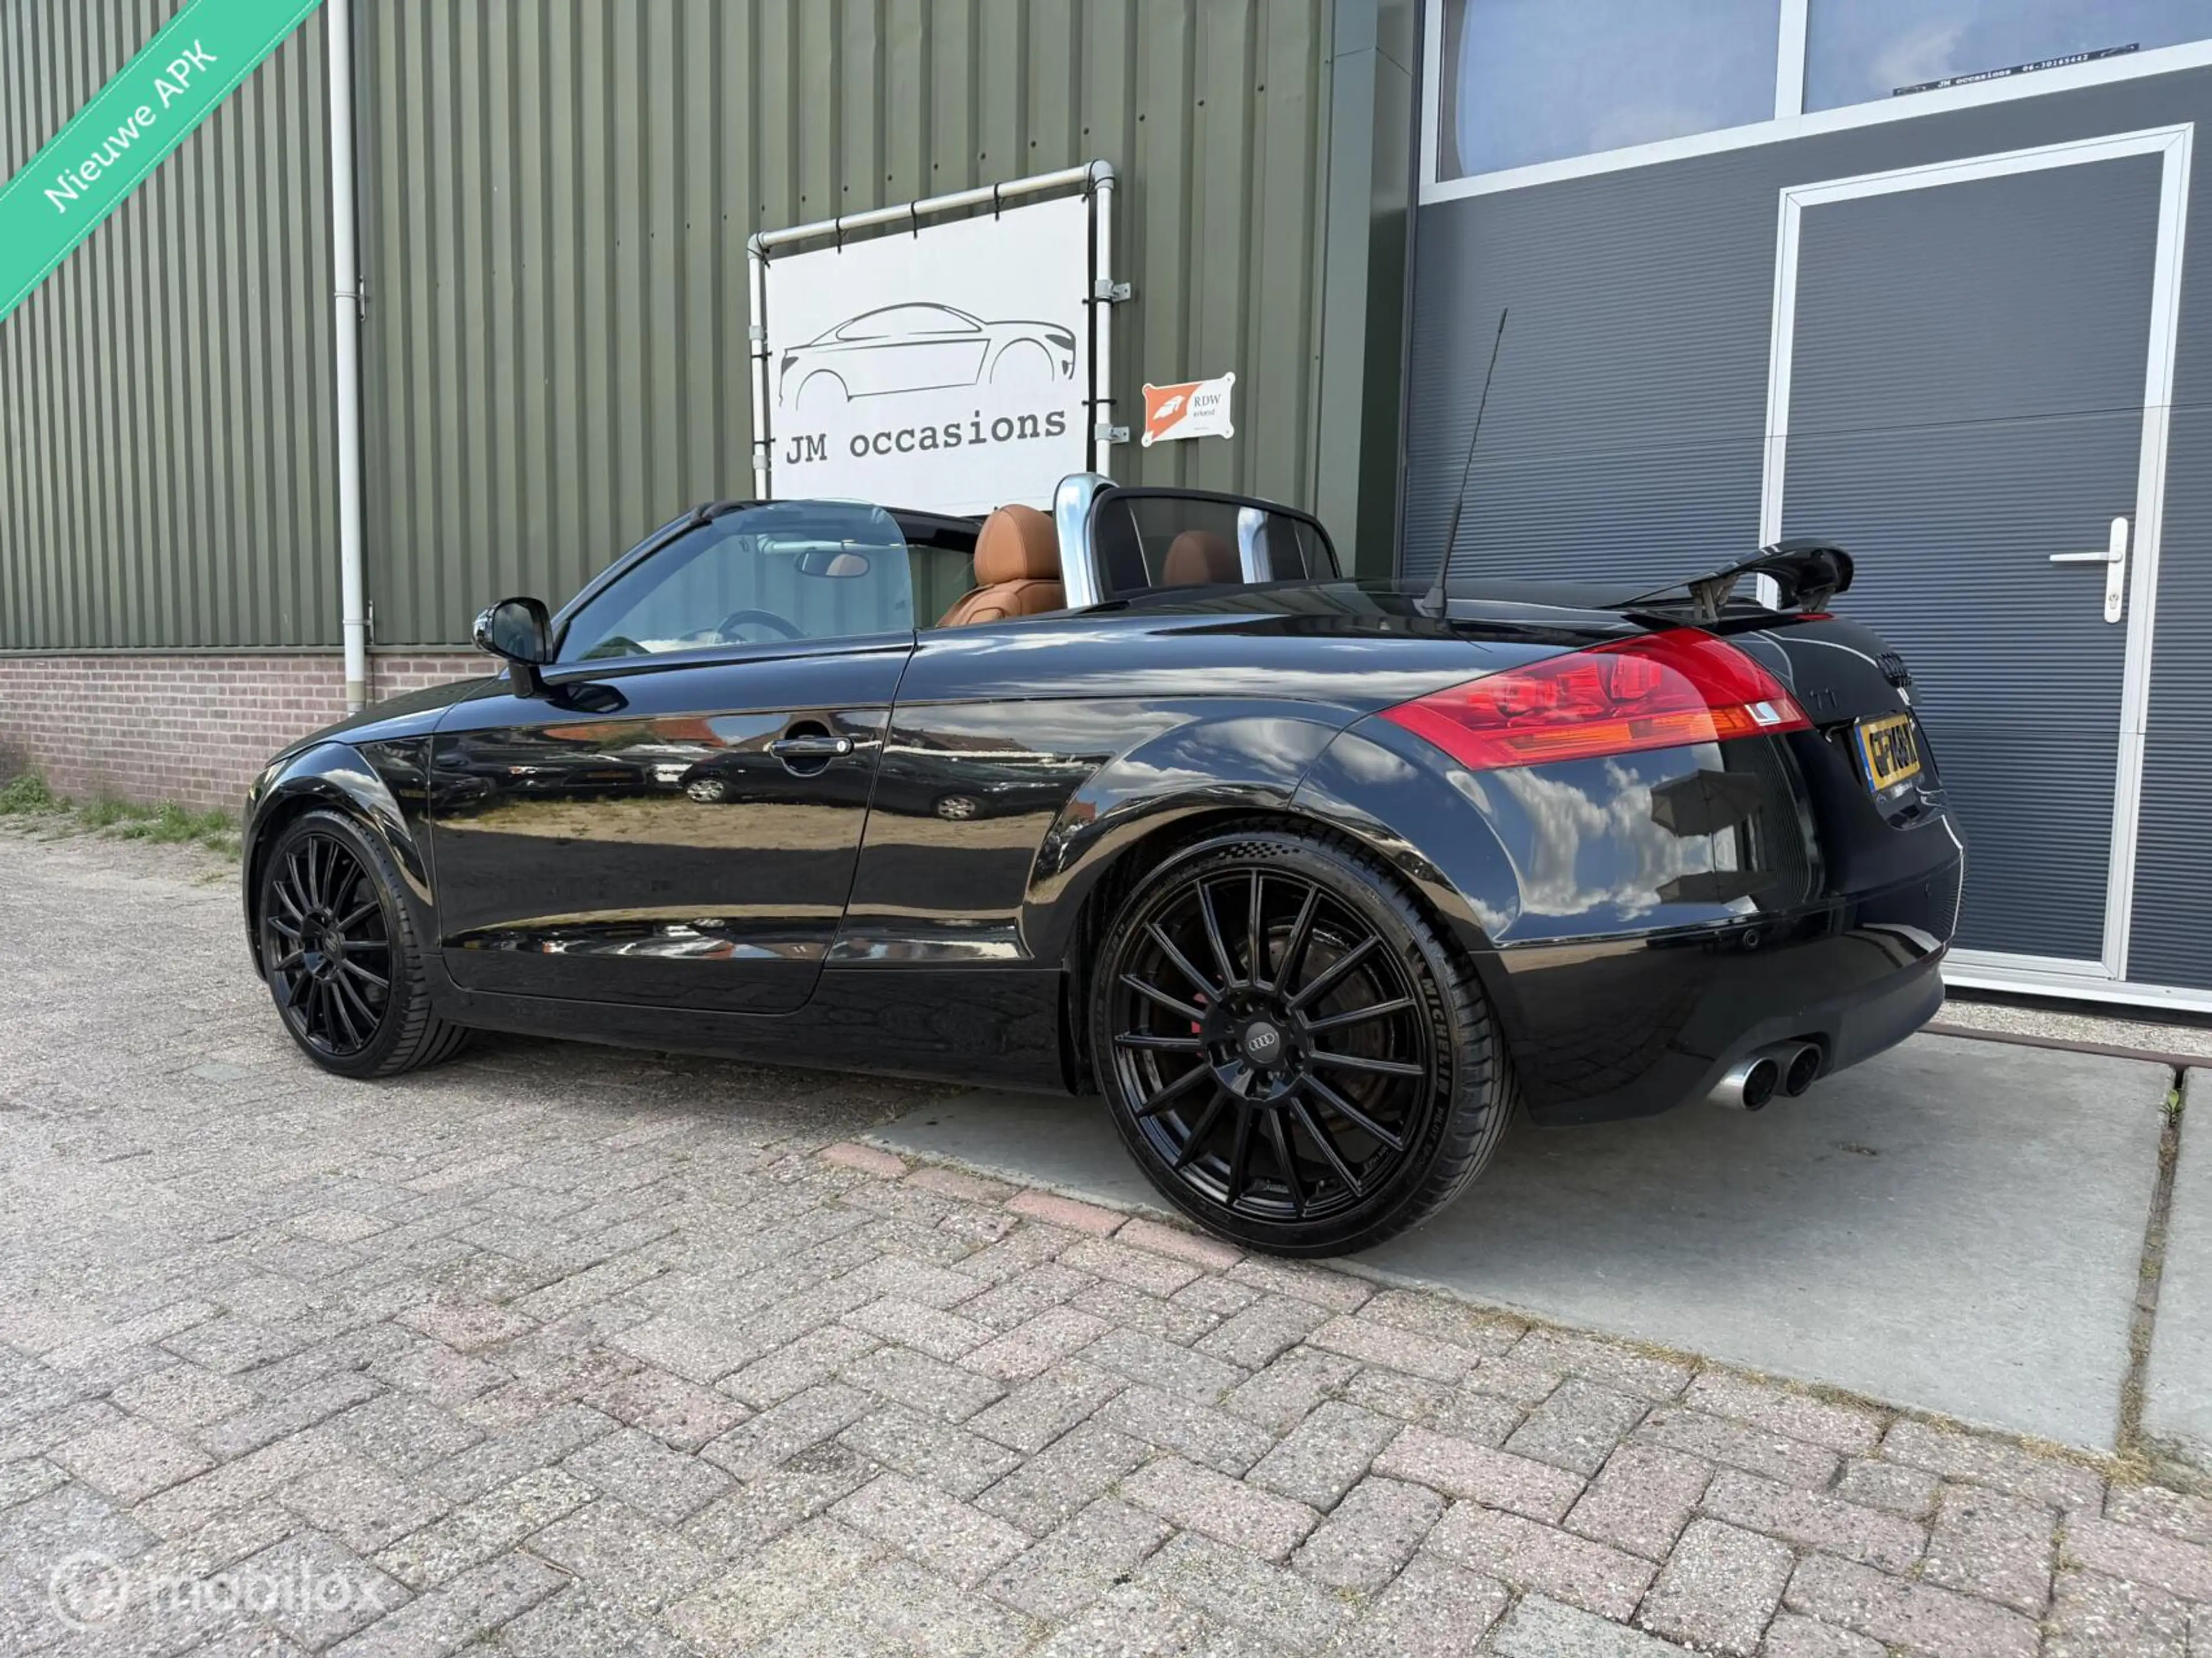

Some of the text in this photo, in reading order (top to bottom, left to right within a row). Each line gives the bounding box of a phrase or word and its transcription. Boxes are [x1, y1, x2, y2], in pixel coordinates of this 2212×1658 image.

[1194, 394, 1221, 407] RDW
[786, 409, 1066, 464] JM occasions
[1422, 978, 1452, 1095] MICHELIN
